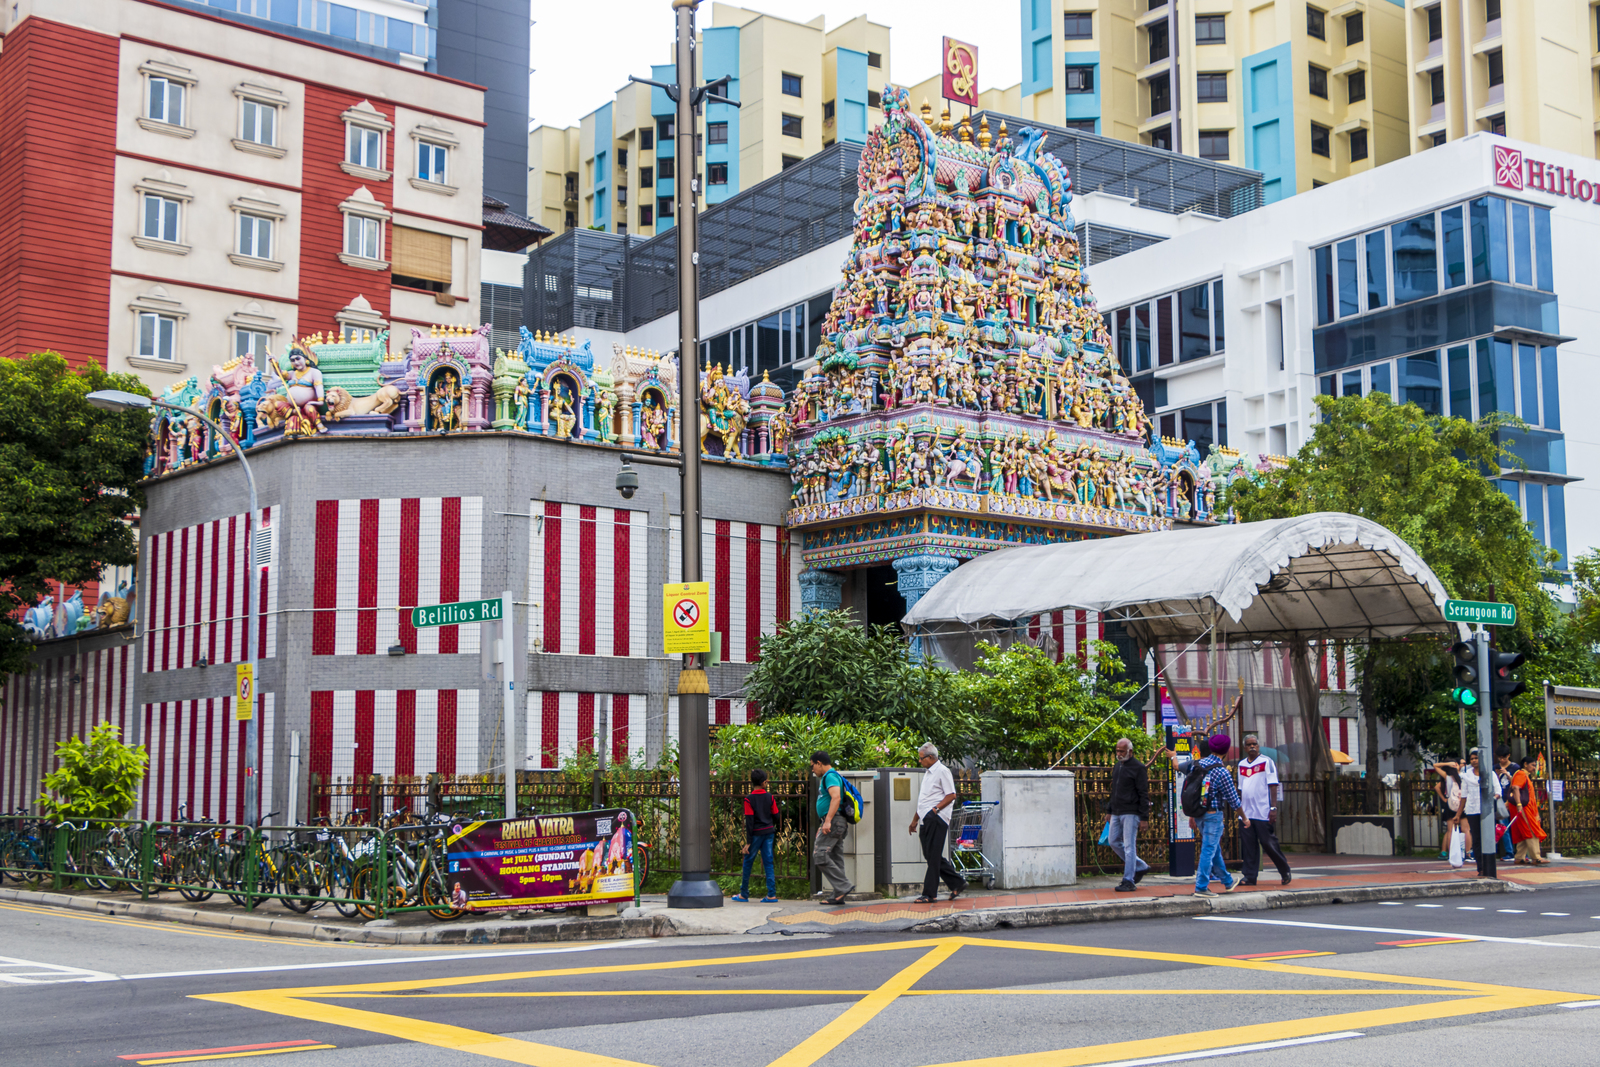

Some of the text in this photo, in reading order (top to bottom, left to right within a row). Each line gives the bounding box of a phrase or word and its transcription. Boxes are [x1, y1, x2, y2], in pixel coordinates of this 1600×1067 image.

[419, 601, 498, 624] Belilios Rd
[1449, 602, 1512, 620] Serangoon Rd
[1555, 706, 1565, 715] SRI
[1175, 743, 1190, 751] INDIA
[502, 820, 537, 840] RATHA
[539, 817, 574, 837] YATRA
[494, 841, 523, 850] FESTIVAL
[534, 836, 564, 846] CHARIOTS
[566, 835, 581, 843] 2018
[514, 855, 533, 865] JULY
[535, 851, 574, 863] (SUNDAY)
[500, 862, 580, 875] HOUGANG STADIUM
[519, 876, 535, 884] 5pm
[542, 874, 562, 883] 10pm
